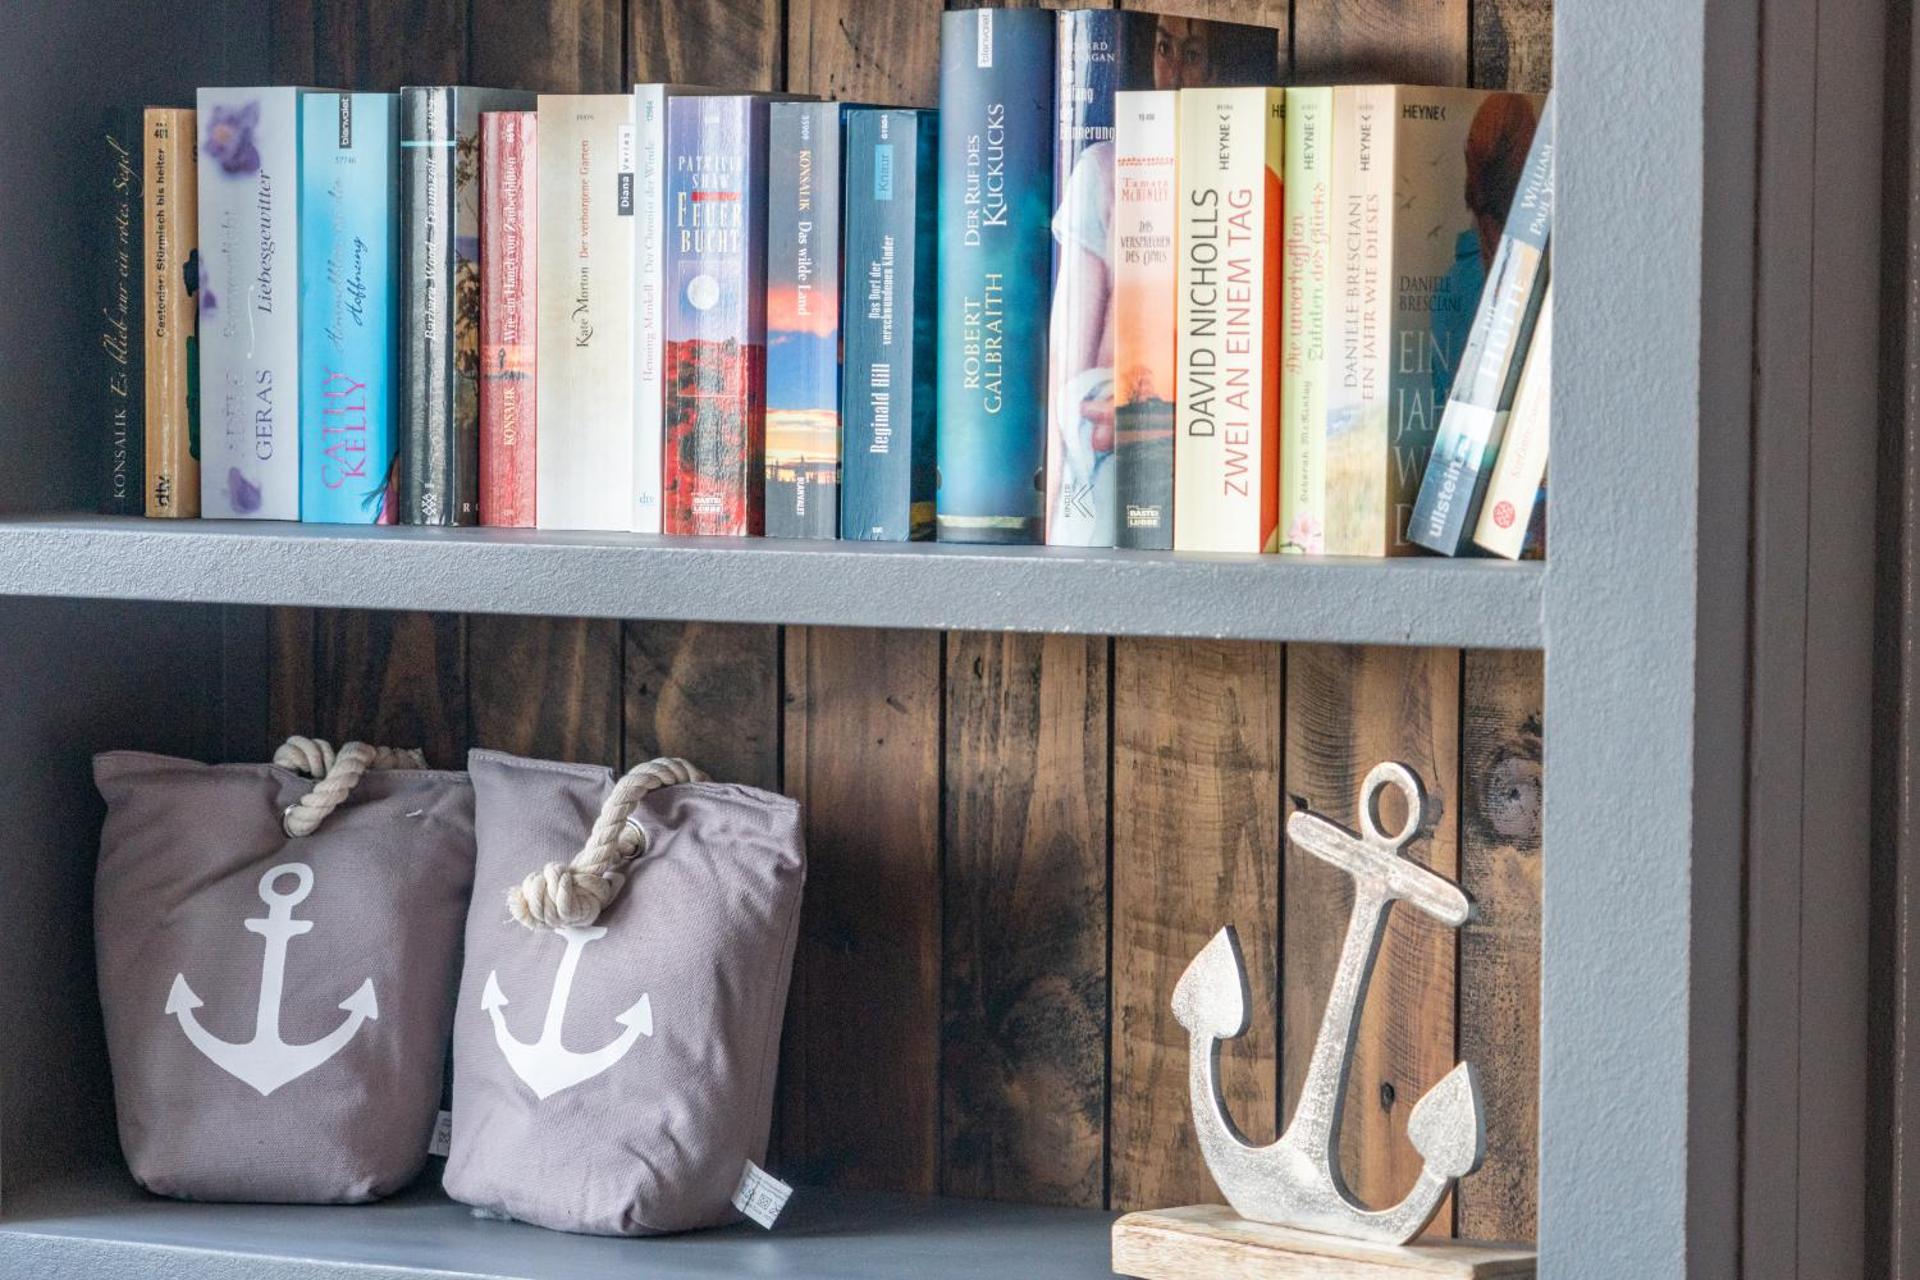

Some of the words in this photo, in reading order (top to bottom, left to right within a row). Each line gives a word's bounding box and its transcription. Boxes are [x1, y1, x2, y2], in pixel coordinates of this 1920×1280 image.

[980, 13, 991, 63] blanvalet
[341, 97, 351, 146] blanvalet
[1402, 104, 1438, 121] HEYNE
[105, 136, 143, 197] Segel
[156, 148, 166, 184] heiter
[579, 138, 590, 175] Garten
[966, 134, 980, 167] DES
[982, 102, 1008, 227] KUCKUCKS
[1218, 123, 1231, 171] HEYNE
[1303, 123, 1316, 170] HEYNE
[1360, 123, 1372, 172] HEYNE
[156, 186, 166, 206] bis
[424, 157, 437, 229] Traumzeit
[619, 175, 630, 208] Diana
[798, 150, 813, 212] KONSALIK
[964, 169, 981, 205] RUF
[115, 202, 130, 245] rotes
[578, 178, 592, 237] verborgene
[964, 209, 981, 247] DER
[1227, 188, 1253, 247] TAG
[1364, 193, 1380, 259] DIESES
[155, 207, 167, 272] Stürmisch
[255, 168, 278, 313] Liebesgewitter
[579, 238, 590, 259] Der
[681, 230, 740, 254] BUCHT
[797, 221, 813, 244] Das
[882, 234, 894, 266] Kinder
[1345, 194, 1363, 298] BRESCIANI
[115, 252, 130, 278] ein
[344, 236, 368, 326] Hoffnung
[423, 240, 436, 281] Wood
[798, 248, 813, 281] wilde
[868, 260, 881, 278] der
[1190, 188, 1219, 336] NICHOLLS
[118, 281, 130, 314] nur
[570, 266, 589, 321] Morton
[797, 284, 812, 316] Land
[868, 280, 882, 300] Dorf
[1225, 257, 1252, 355] EINEM
[1363, 267, 1379, 304] WIE
[424, 287, 436, 341] Barbara
[503, 318, 516, 342] Wie
[576, 317, 594, 348] Kate
[868, 302, 881, 319] Das
[1361, 310, 1378, 359] JAHR
[103, 306, 129, 365] blieb
[963, 297, 981, 390] ROBERT
[984, 273, 1004, 414] GALBRAITH
[1342, 301, 1360, 388] DANIELE
[1398, 330, 1452, 374] EIN
[109, 370, 129, 397] Es
[870, 362, 891, 388] Hill
[1188, 347, 1216, 437] DAVID
[1225, 367, 1250, 411] AN
[1361, 366, 1376, 401] EIN
[255, 369, 274, 461] GERAS
[320, 366, 347, 490] CATHY
[343, 371, 367, 478] KELLY
[502, 386, 516, 446] KONSALIK
[869, 392, 893, 454] Reginald
[111, 409, 127, 498] KONSALIK
[1224, 421, 1249, 497] ZWEI
[1428, 460, 1467, 538] ullstein
